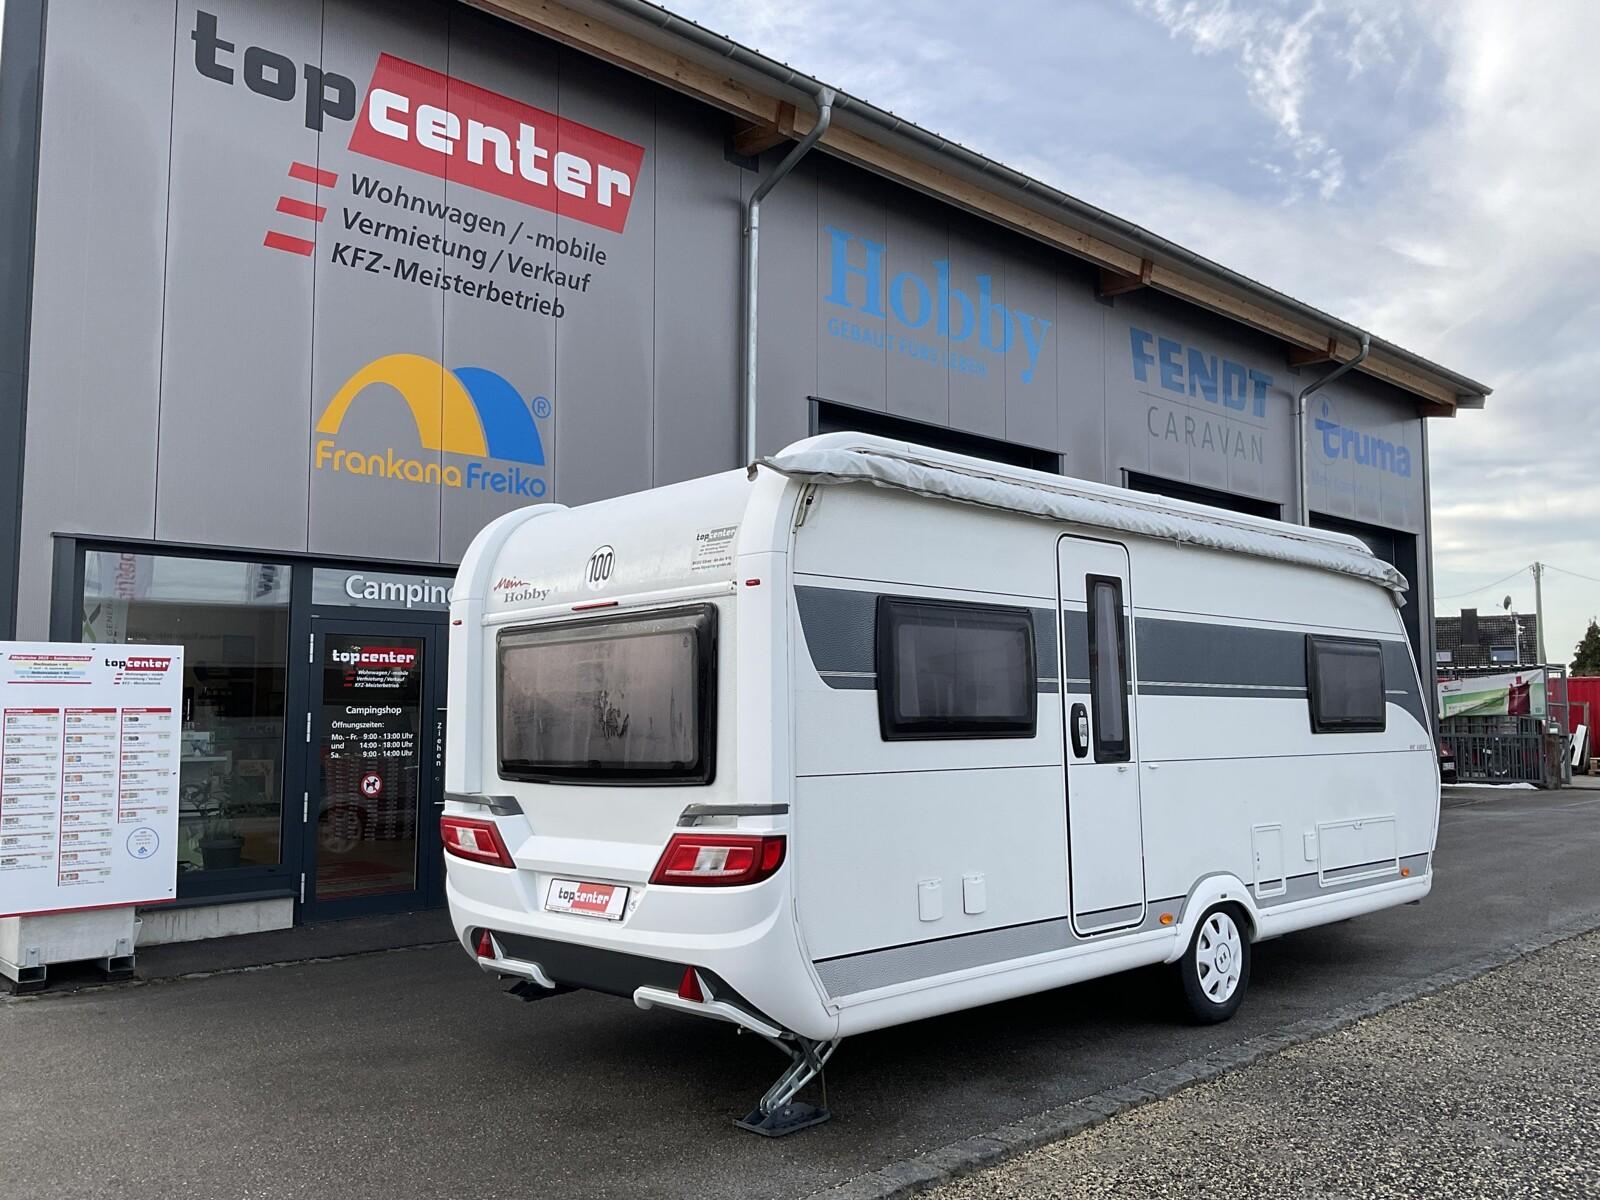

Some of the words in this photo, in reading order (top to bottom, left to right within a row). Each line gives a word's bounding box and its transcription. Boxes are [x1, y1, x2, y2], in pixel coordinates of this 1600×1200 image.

[331, 241, 565, 320] KFZ-Meisterbetrieb
[823, 224, 1052, 385] Hobby
[1129, 326, 1273, 419] FENDT
[1147, 406, 1263, 464] CARAVAN
[1314, 417, 1411, 478] truma
[504, 587, 551, 603] Hobby
[588, 552, 613, 583] 100
[331, 721, 385, 730] Öffnungszeiten:
[346, 705, 402, 716] Campingshop
